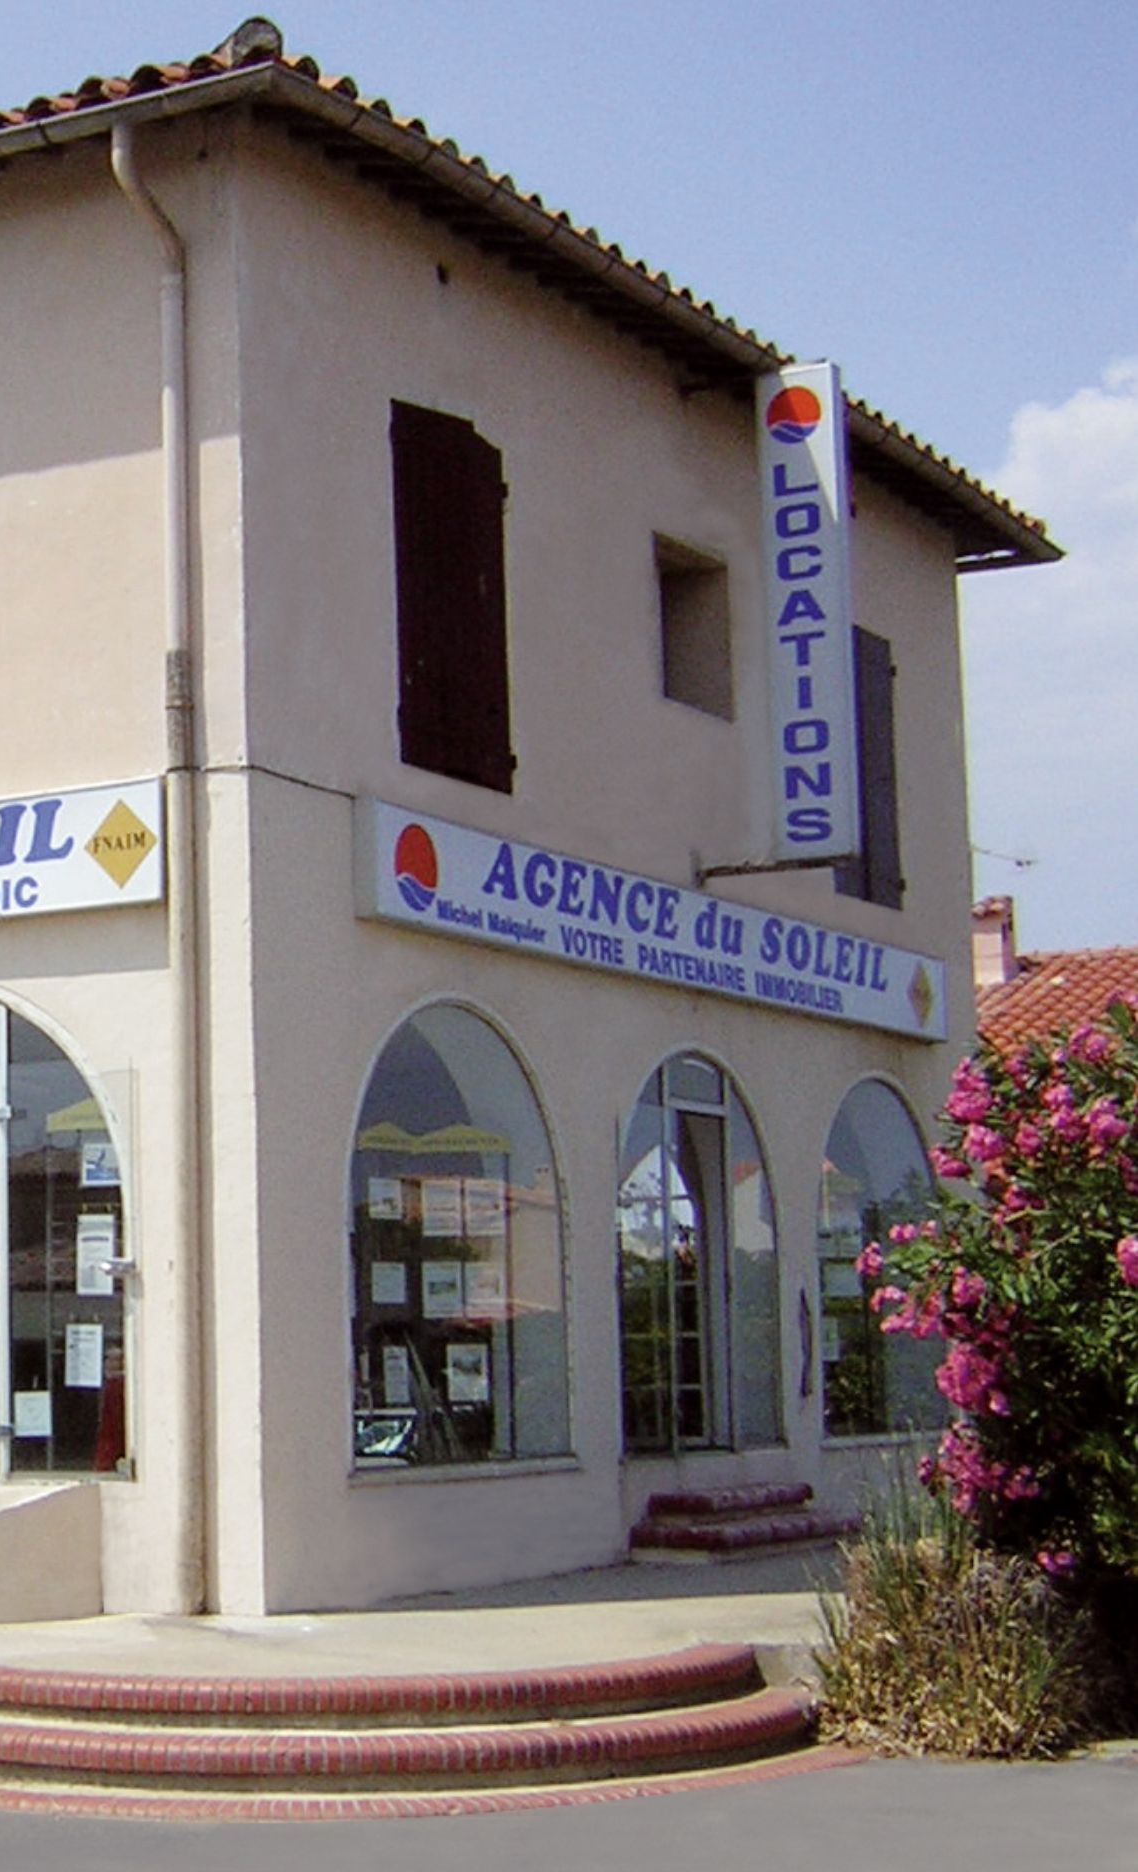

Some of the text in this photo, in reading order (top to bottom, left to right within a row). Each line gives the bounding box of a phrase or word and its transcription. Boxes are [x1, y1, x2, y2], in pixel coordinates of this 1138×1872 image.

[773, 464, 832, 843] LOCATIONS
[92, 831, 146, 855] FNAIM
[437, 899, 483, 929] Michel
[482, 842, 888, 992] AGENCE du SOLEIL
[560, 924, 843, 1013] VOTRE PARTENAIRE IMMOBILIER
